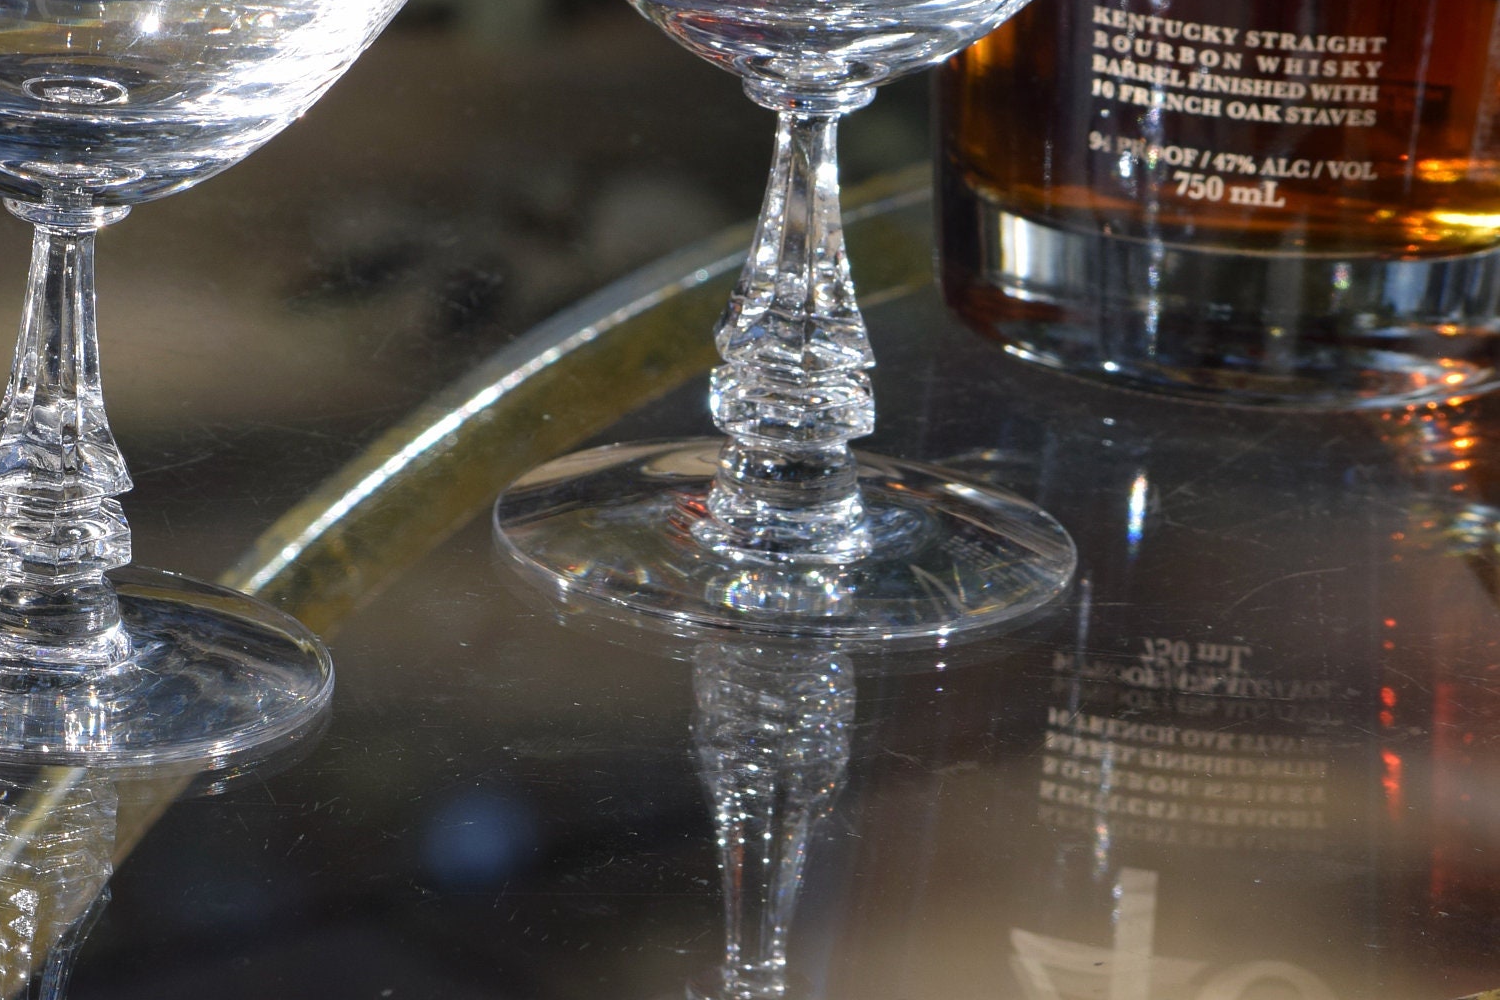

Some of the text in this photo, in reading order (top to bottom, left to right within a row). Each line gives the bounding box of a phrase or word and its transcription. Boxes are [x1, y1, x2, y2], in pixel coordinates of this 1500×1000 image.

[1092, 5, 1388, 54] KENTUCKY STRAIGHT
[1092, 30, 1383, 79] BOURBON WHISKY
[1092, 54, 1380, 102] BARREL FINISHED WITH
[1091, 78, 1377, 127] 10 FRENCH OAK STAVES
[1172, 170, 1287, 208] 750 mL
[1212, 152, 1257, 175] 47%
[1259, 157, 1311, 179] ALC
[1326, 160, 1378, 181] VOL
